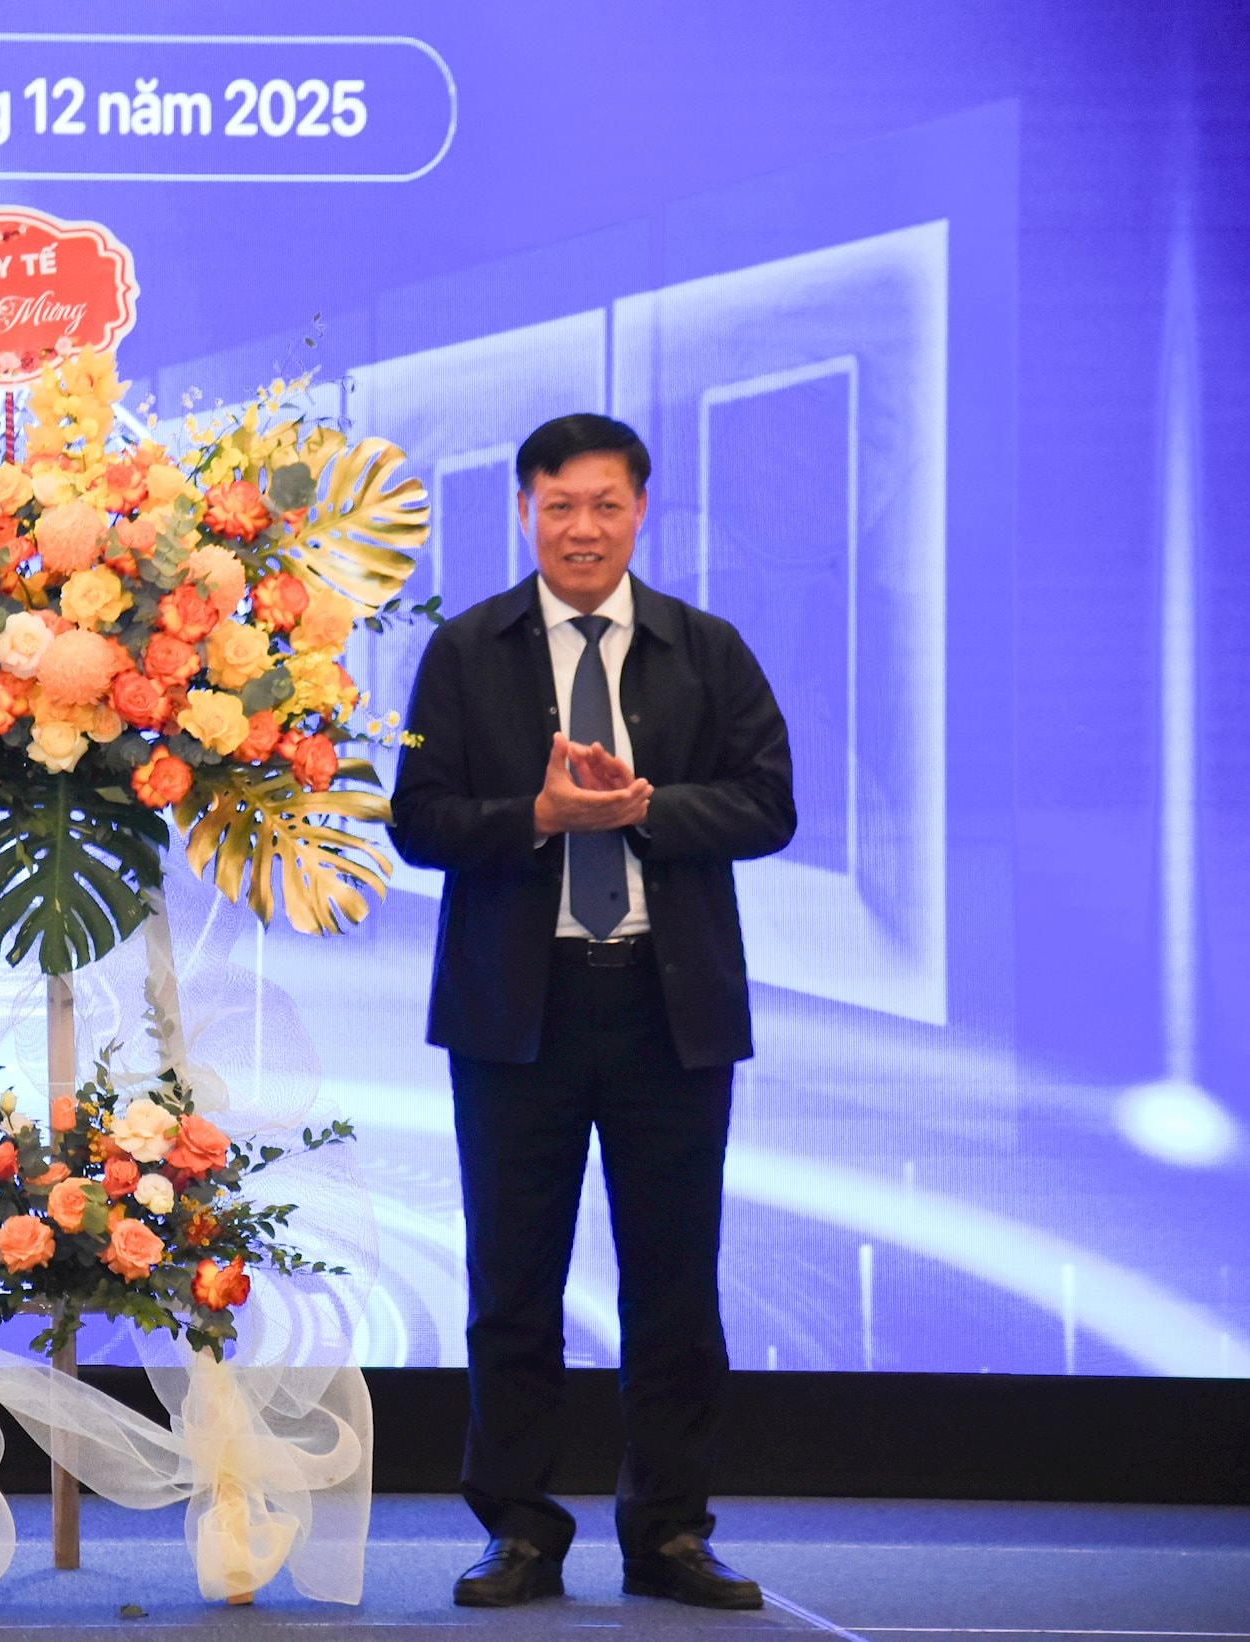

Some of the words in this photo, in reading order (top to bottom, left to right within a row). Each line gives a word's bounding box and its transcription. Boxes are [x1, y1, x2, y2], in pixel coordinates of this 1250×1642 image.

[22, 76, 87, 136] 12
[97, 76, 213, 137] năm
[223, 77, 368, 138] 2025
[20, 242, 59, 276] TẾ
